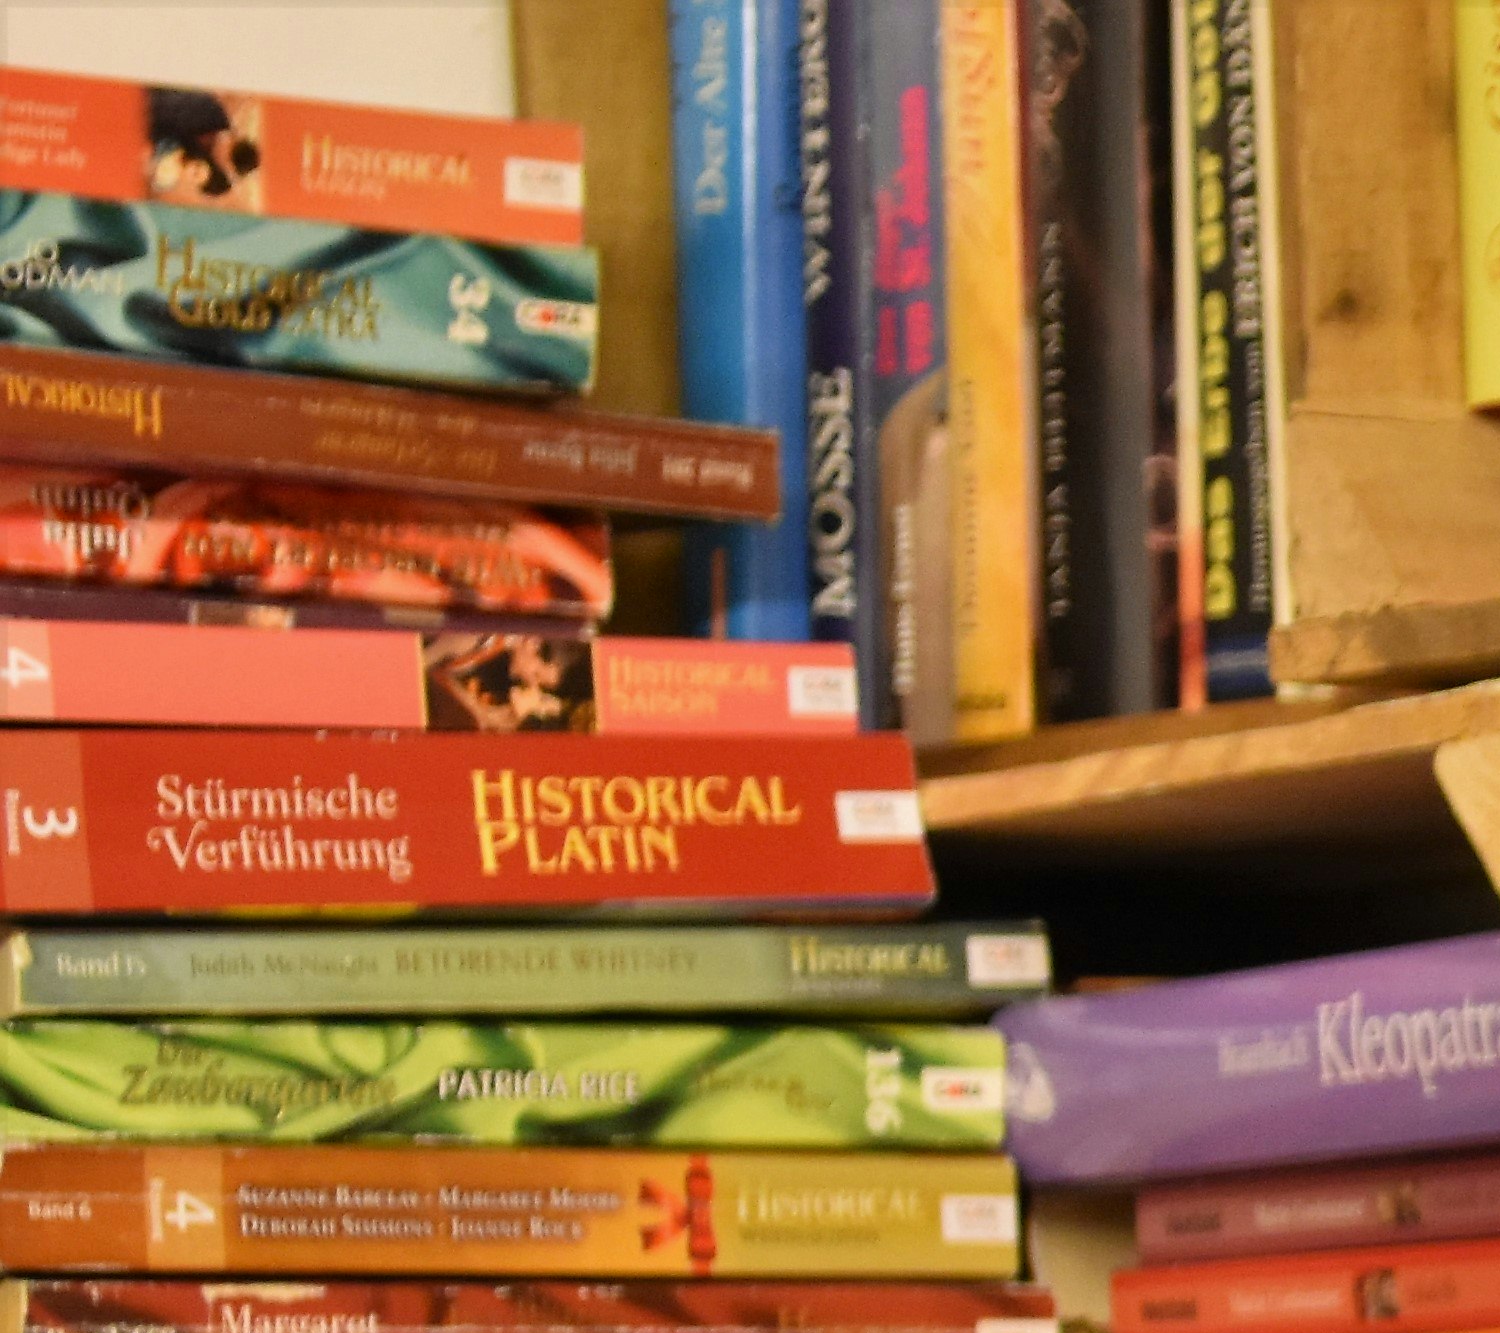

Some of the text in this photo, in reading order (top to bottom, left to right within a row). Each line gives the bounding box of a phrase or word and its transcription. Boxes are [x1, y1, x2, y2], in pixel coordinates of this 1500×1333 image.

[1196, 149, 1237, 620] Das Erbe der
[812, 367, 857, 615] MOSSE
[148, 824, 680, 879] Verführung PLATIN
[156, 770, 798, 827] Stürmische HISTORICAL
